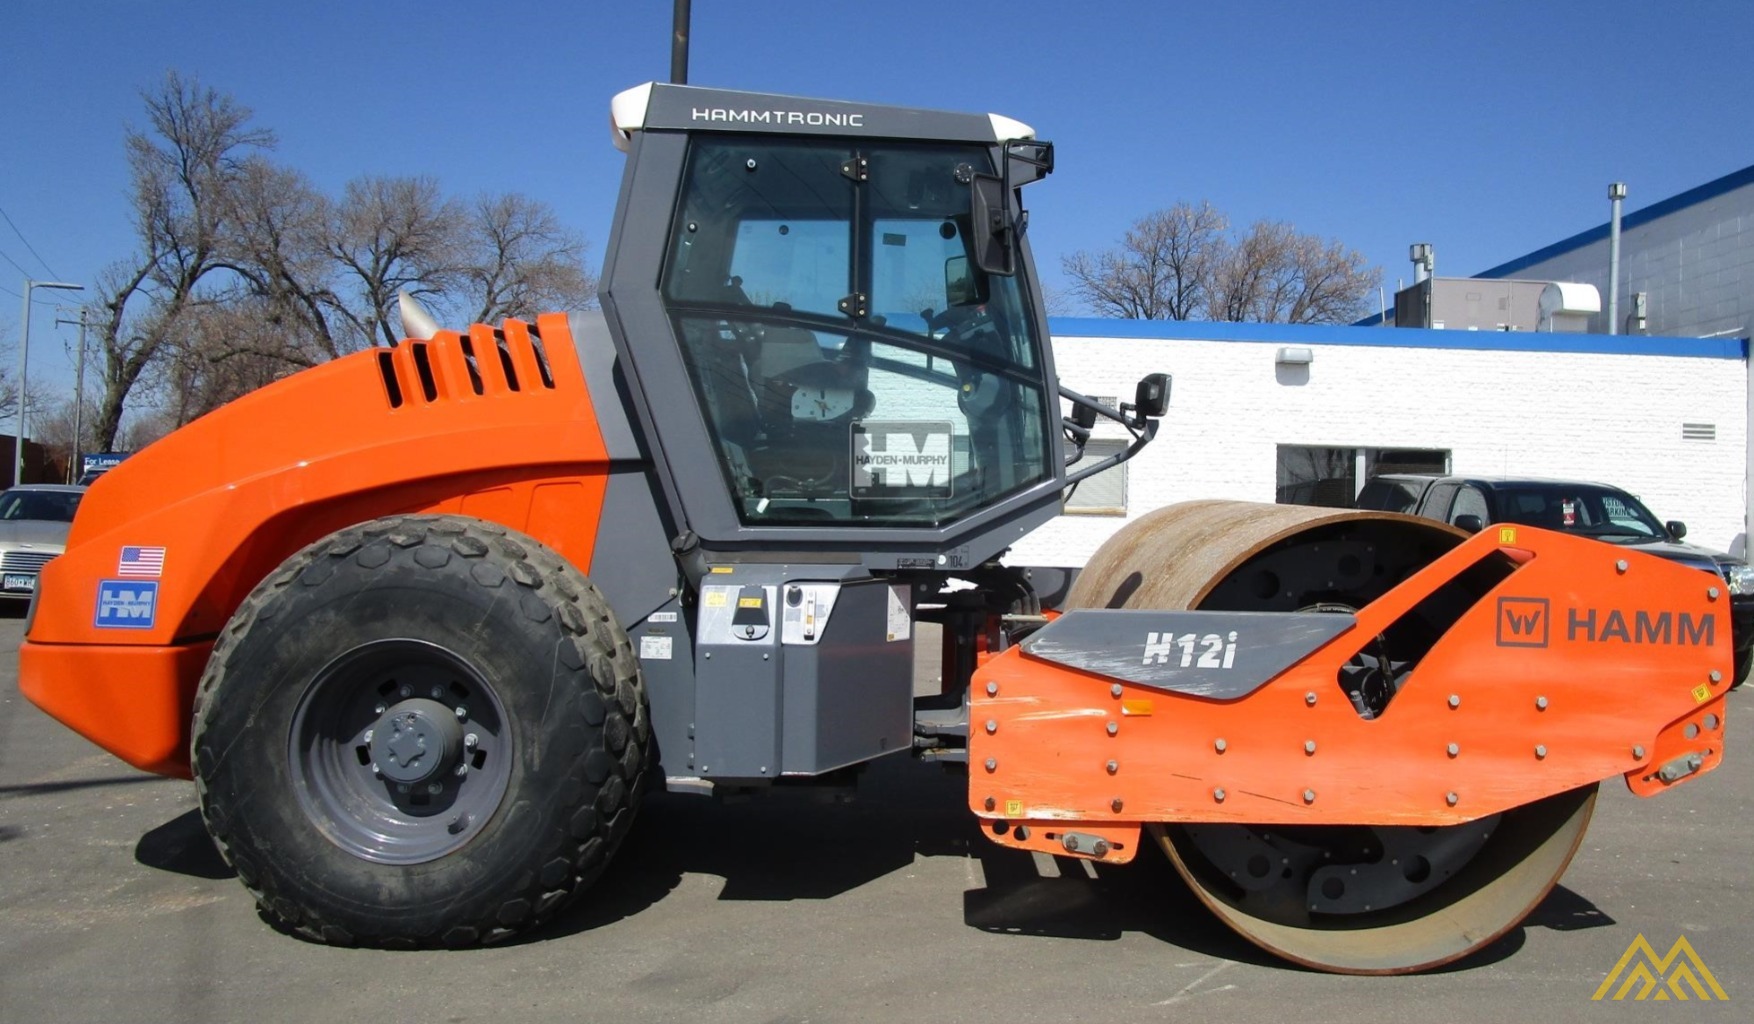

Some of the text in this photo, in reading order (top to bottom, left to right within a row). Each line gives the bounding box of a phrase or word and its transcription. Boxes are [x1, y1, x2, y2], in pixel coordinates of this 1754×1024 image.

[692, 107, 863, 127] HAMMTRONIC
[84, 457, 97, 465] For
[1567, 608, 1715, 646] HAMM
[1142, 631, 1238, 669] H12i
